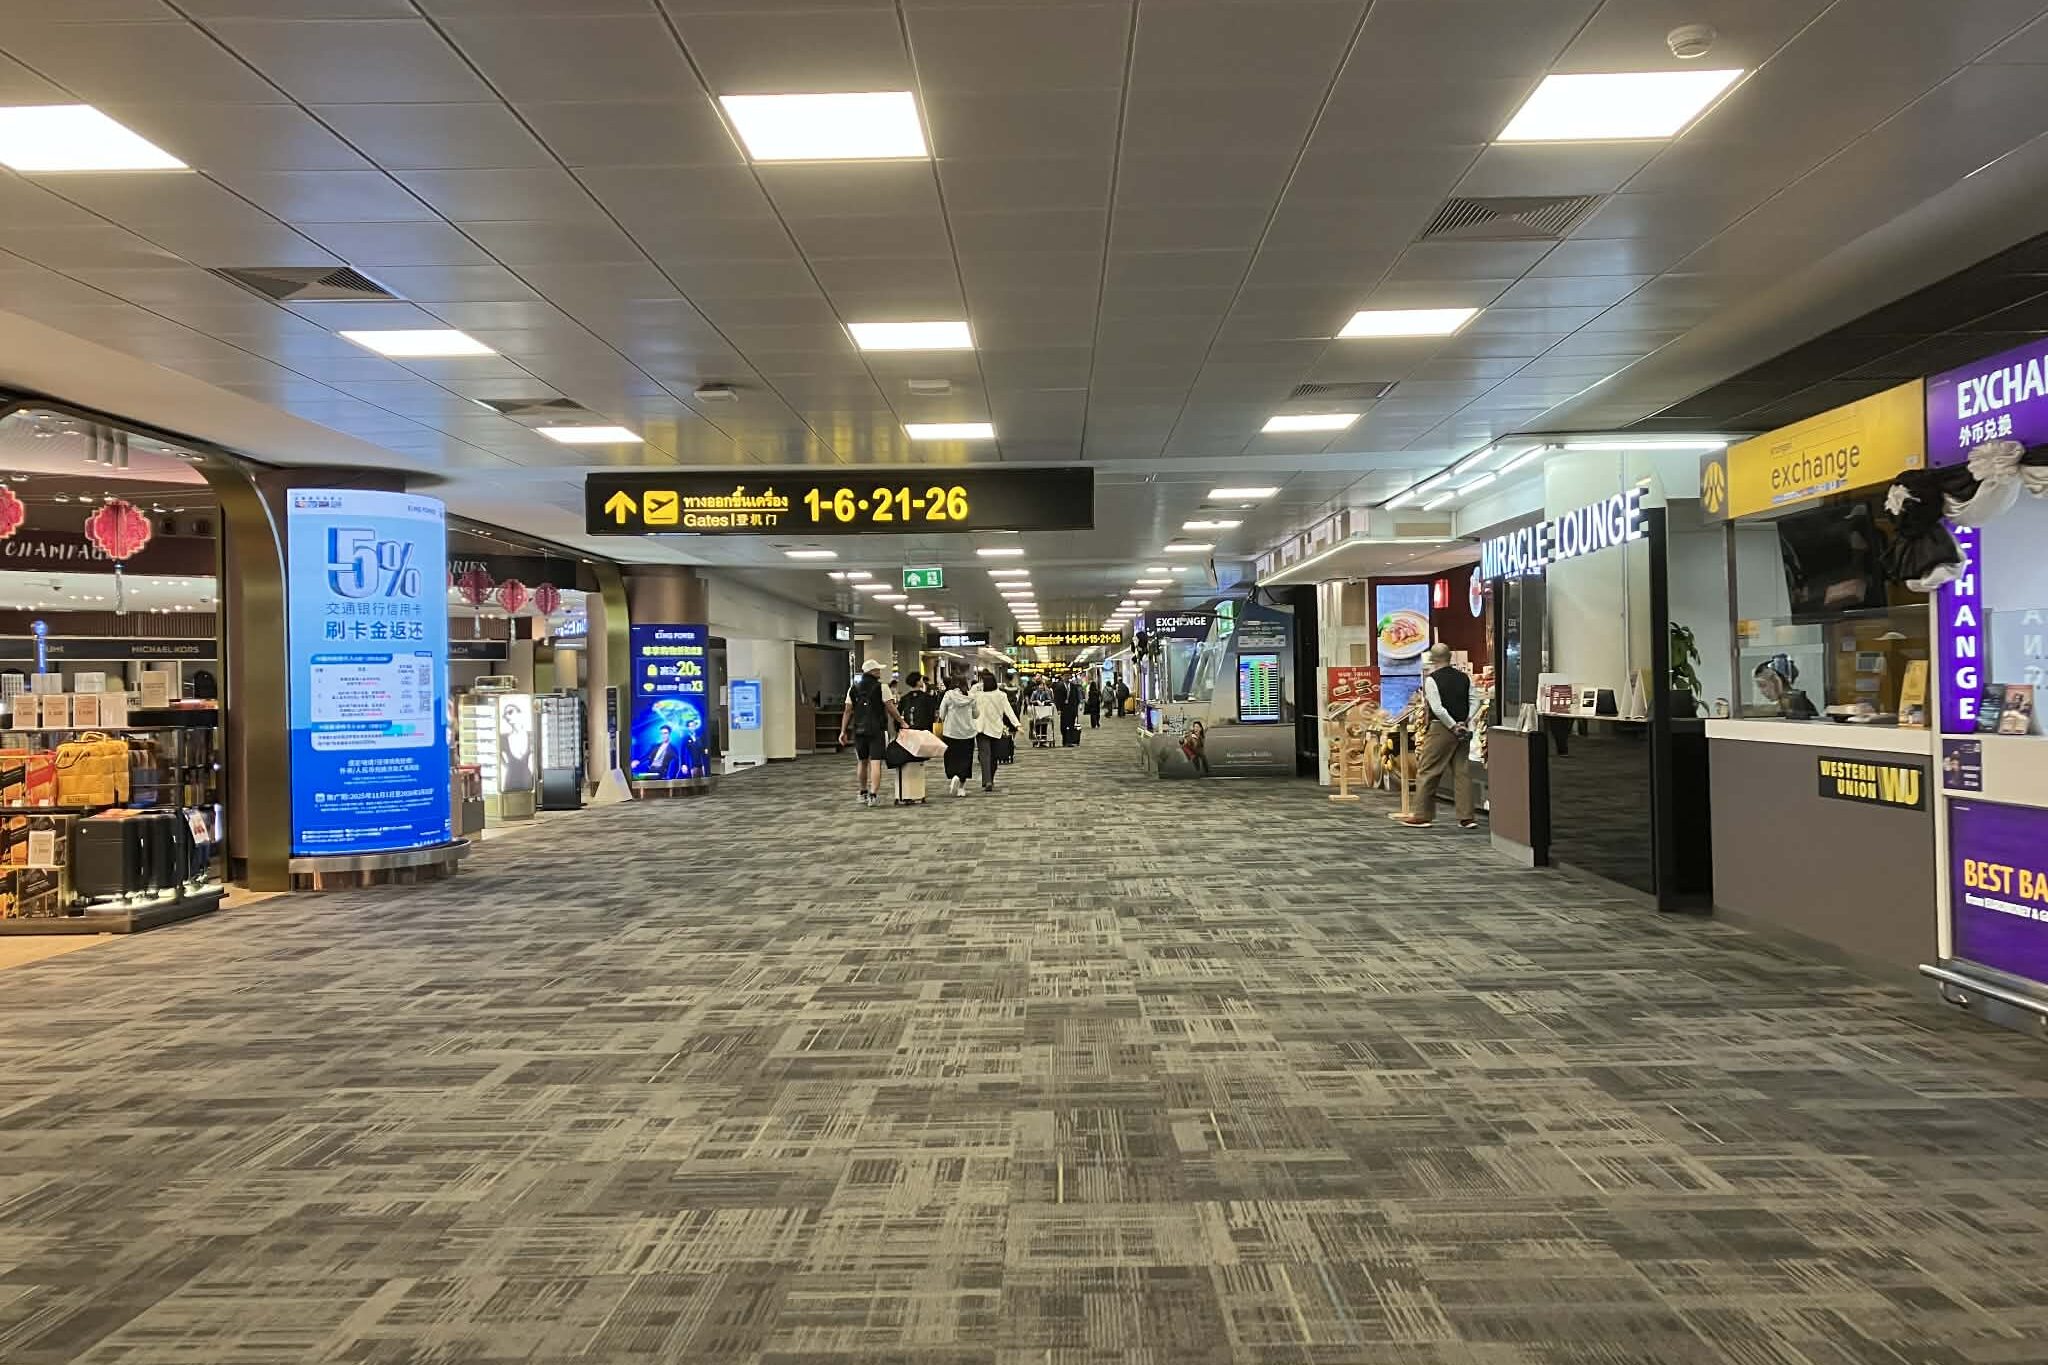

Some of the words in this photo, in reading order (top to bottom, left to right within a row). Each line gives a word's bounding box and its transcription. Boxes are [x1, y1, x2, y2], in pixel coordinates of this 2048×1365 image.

[1959, 414, 2013, 447] 外币兑换
[1772, 445, 1860, 490] exchange
[683, 486, 789, 508] ทางออกขึ้นเครื่อง
[684, 514, 728, 527] Gates
[736, 514, 777, 527] 登机门
[1482, 521, 1549, 580] MIRACLE
[1555, 487, 1642, 561] LOUNGE
[328, 526, 422, 598] 5%
[326, 602, 423, 616] 交通银行信用卡
[326, 620, 423, 640] 刷卡金返还
[1820, 760, 1877, 782] WESTERN
[1837, 778, 1877, 799] UNION
[1964, 859, 2014, 894] BEST
